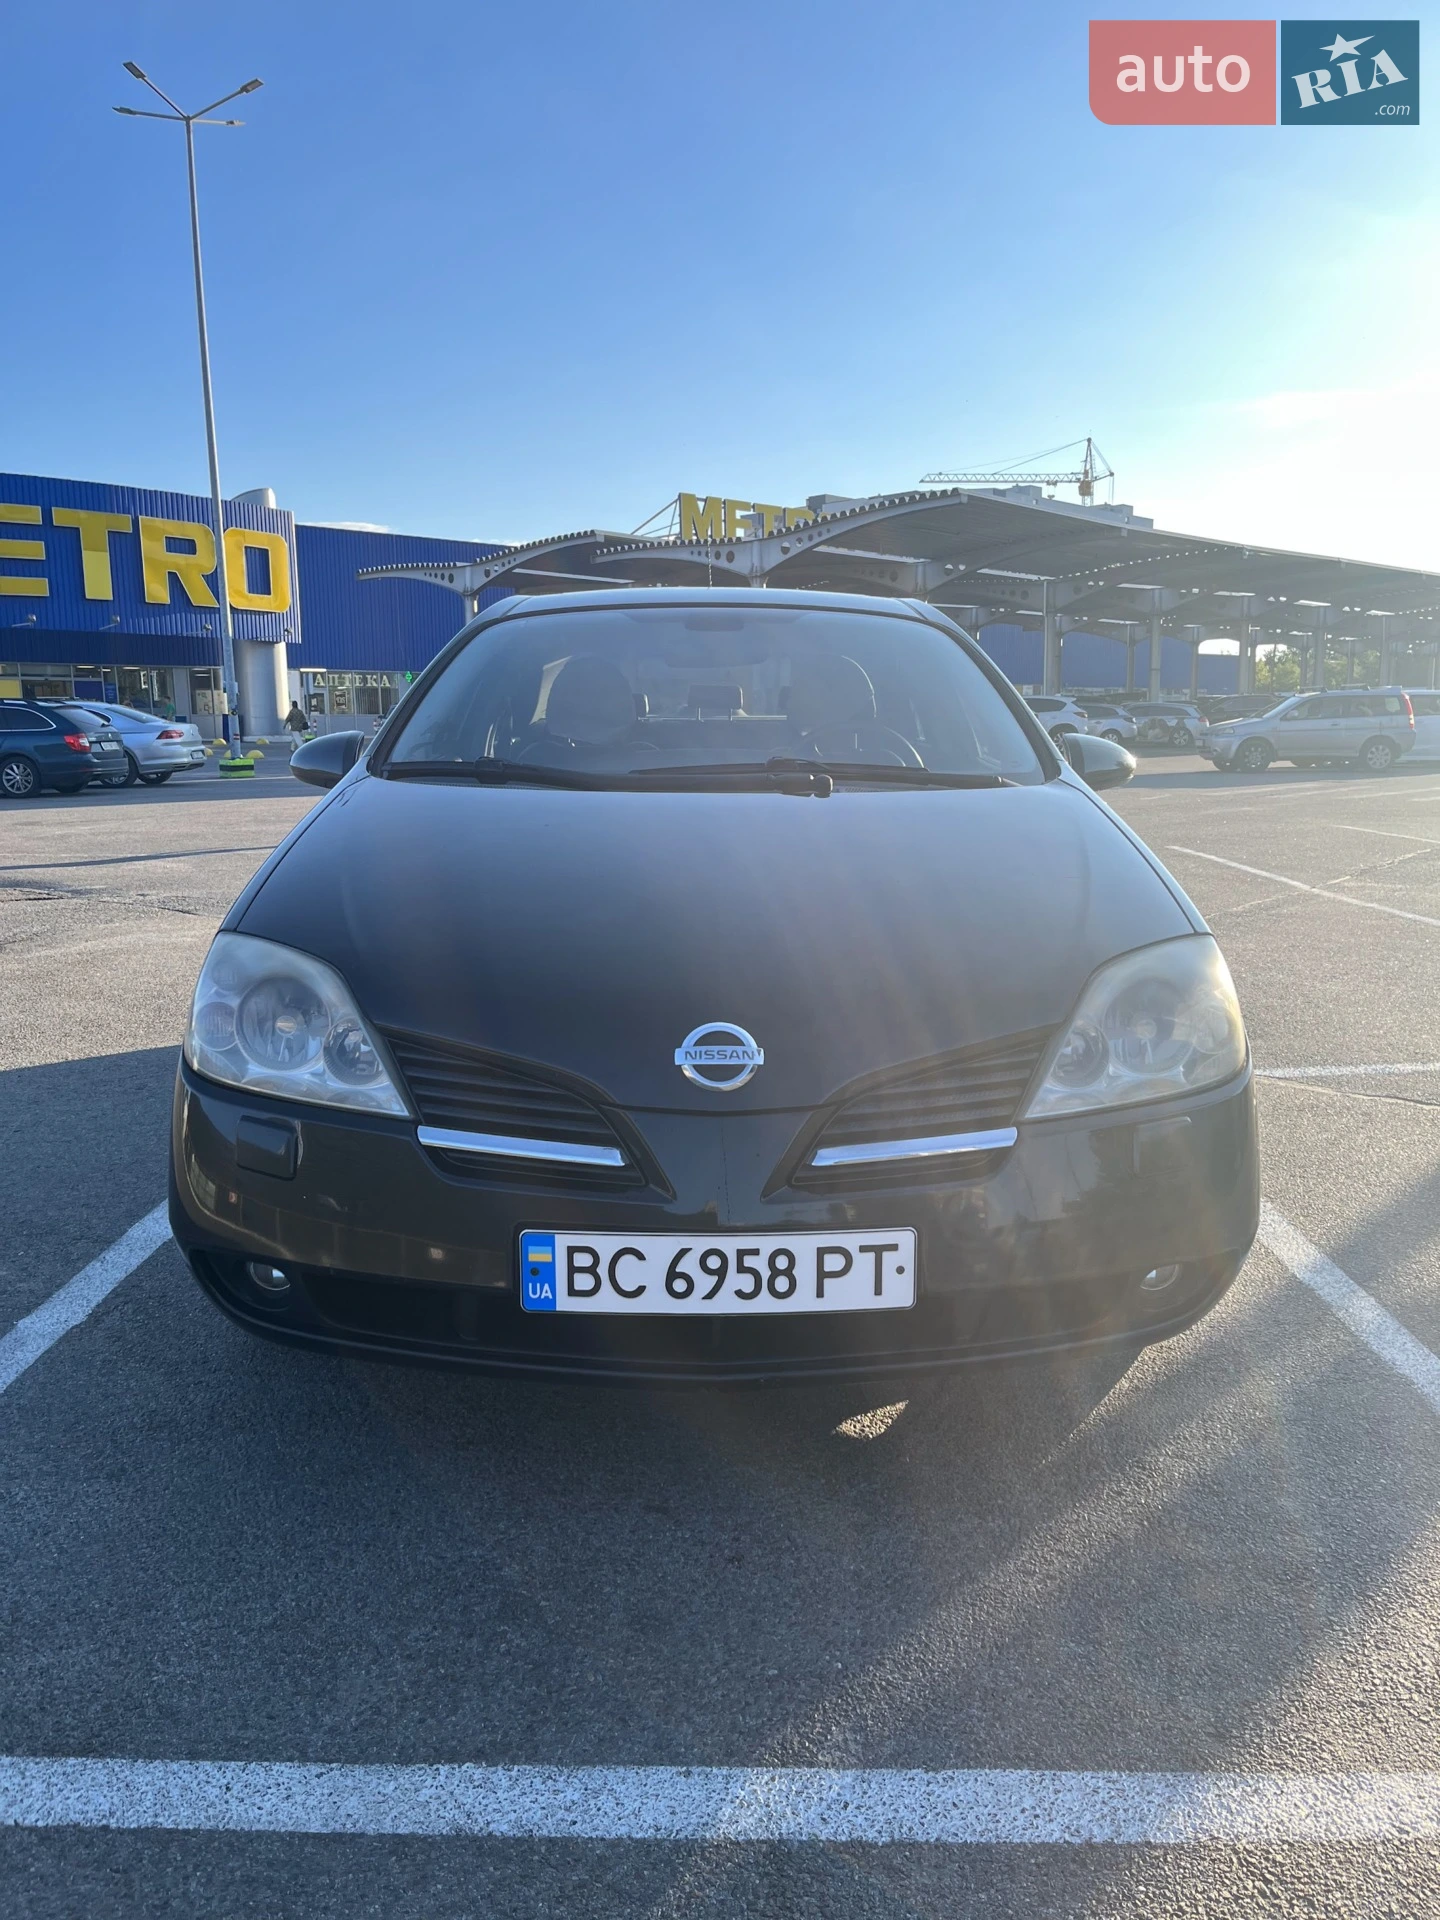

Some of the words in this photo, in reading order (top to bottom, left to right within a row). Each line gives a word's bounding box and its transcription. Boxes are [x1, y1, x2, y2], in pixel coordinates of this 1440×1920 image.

[314, 674, 390, 687] АПТЕКА
[685, 1049, 755, 1060] NISSAN
[567, 1245, 647, 1298] BC
[664, 1247, 797, 1300] 6958
[816, 1243, 899, 1298] PT
[528, 1283, 553, 1299] UA
